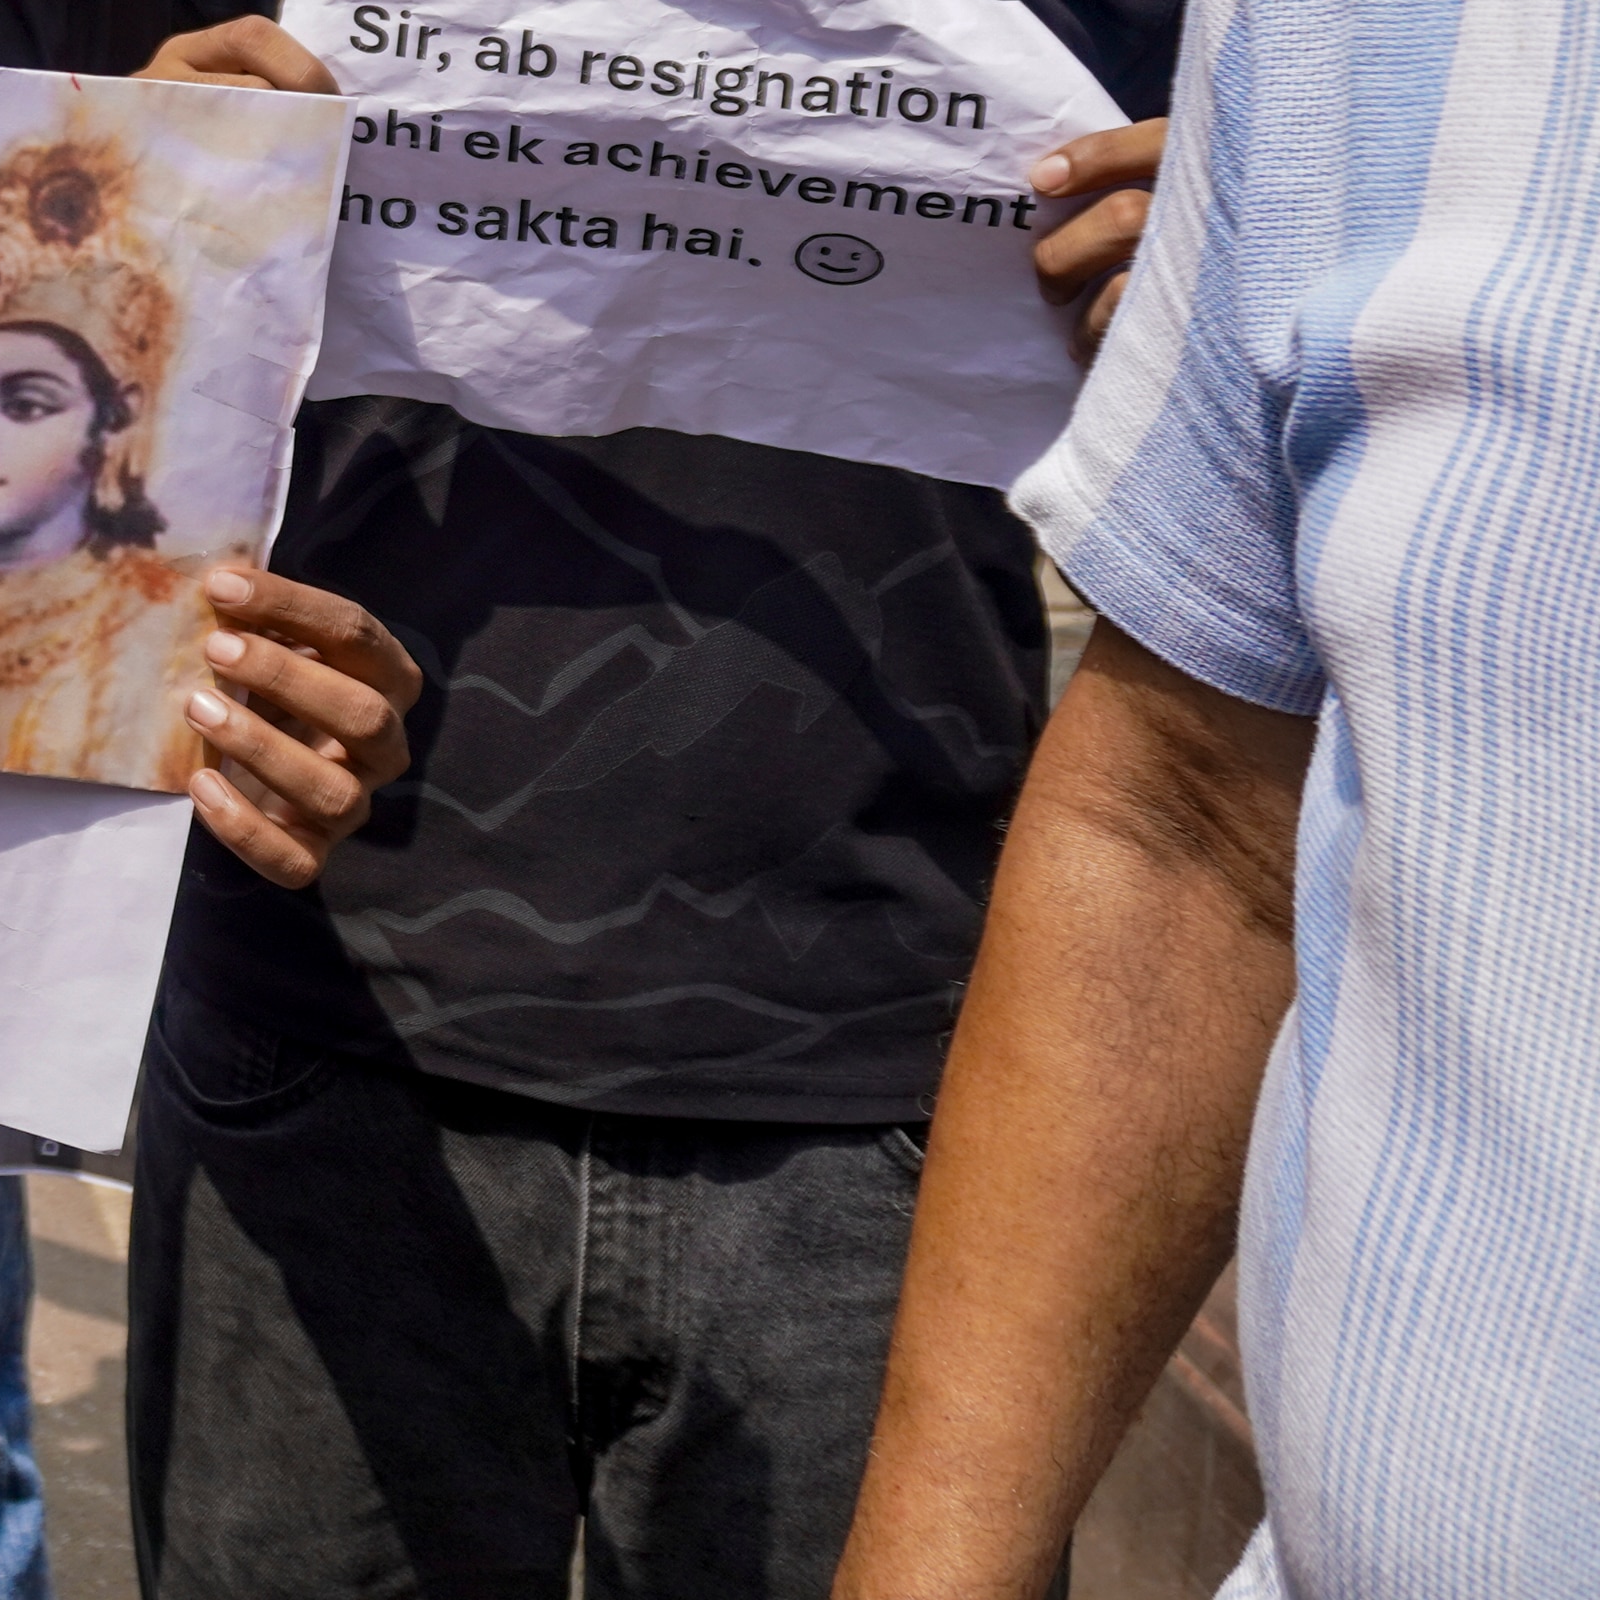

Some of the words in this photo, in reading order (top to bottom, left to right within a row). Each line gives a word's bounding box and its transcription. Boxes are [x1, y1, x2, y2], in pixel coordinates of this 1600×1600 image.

[349, 4, 452, 73] Sir,
[474, 28, 558, 79] ab
[579, 50, 989, 131] resignation
[339, 184, 418, 230] ho
[436, 198, 619, 250] sakta
[641, 212, 763, 269] hai.
[463, 124, 547, 165] ek
[562, 139, 1039, 232] achievement
